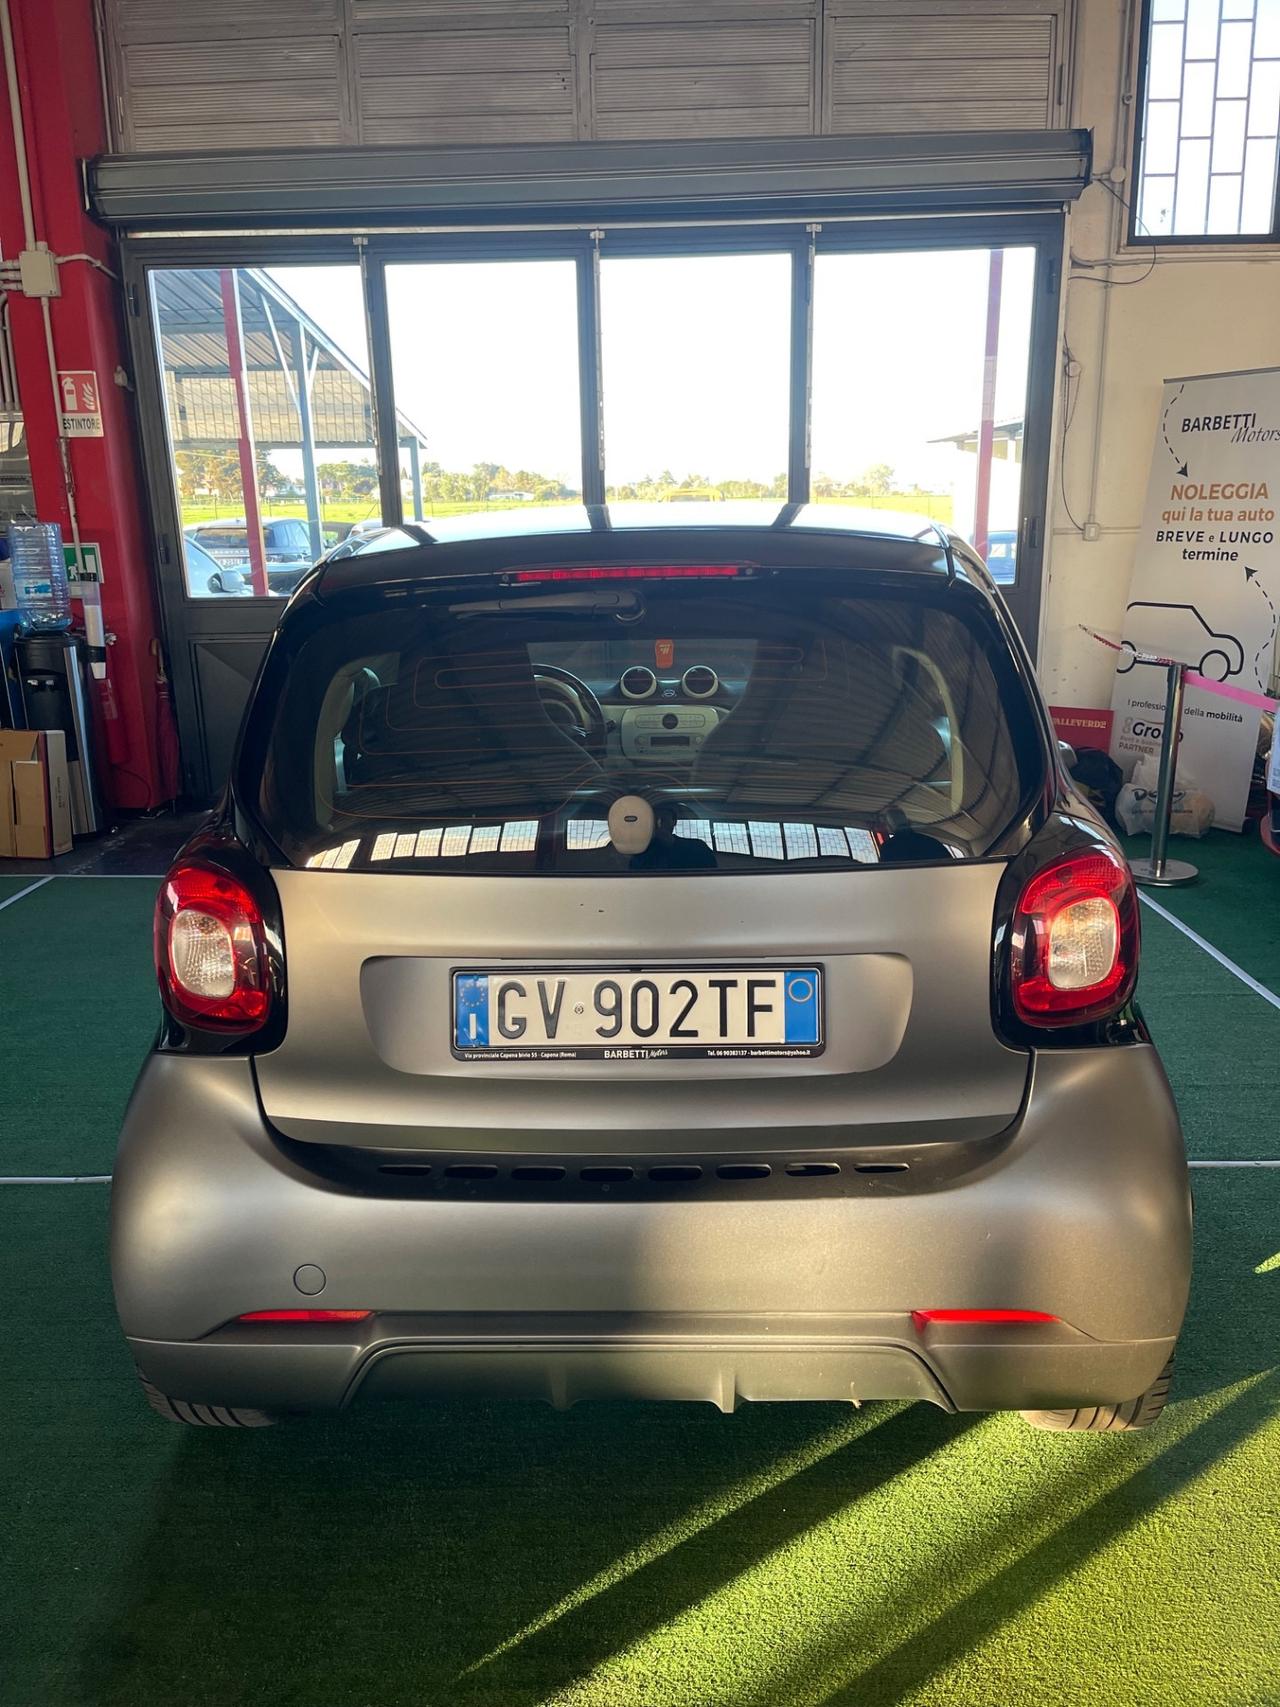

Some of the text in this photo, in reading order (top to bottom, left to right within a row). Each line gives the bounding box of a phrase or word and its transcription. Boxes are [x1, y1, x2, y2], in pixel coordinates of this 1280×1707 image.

[63, 418, 100, 430] ESTINTORE
[1181, 413, 1256, 432] BARBETTI
[1231, 426, 1280, 443] Motors
[1170, 483, 1269, 500] NOLEGGIA
[1162, 507, 1275, 524] qui la tua auto
[1156, 531, 1274, 543] BREVE e LUNGO
[1182, 547, 1239, 561] termine
[1131, 700, 1168, 711] professio
[1184, 706, 1204, 717] della
[1206, 710, 1243, 723] mobilità
[1118, 742, 1154, 755] PARTNER
[497, 980, 567, 1040] GV
[593, 979, 777, 1039] 902TF
[604, 1050, 648, 1059] BARBETTI
